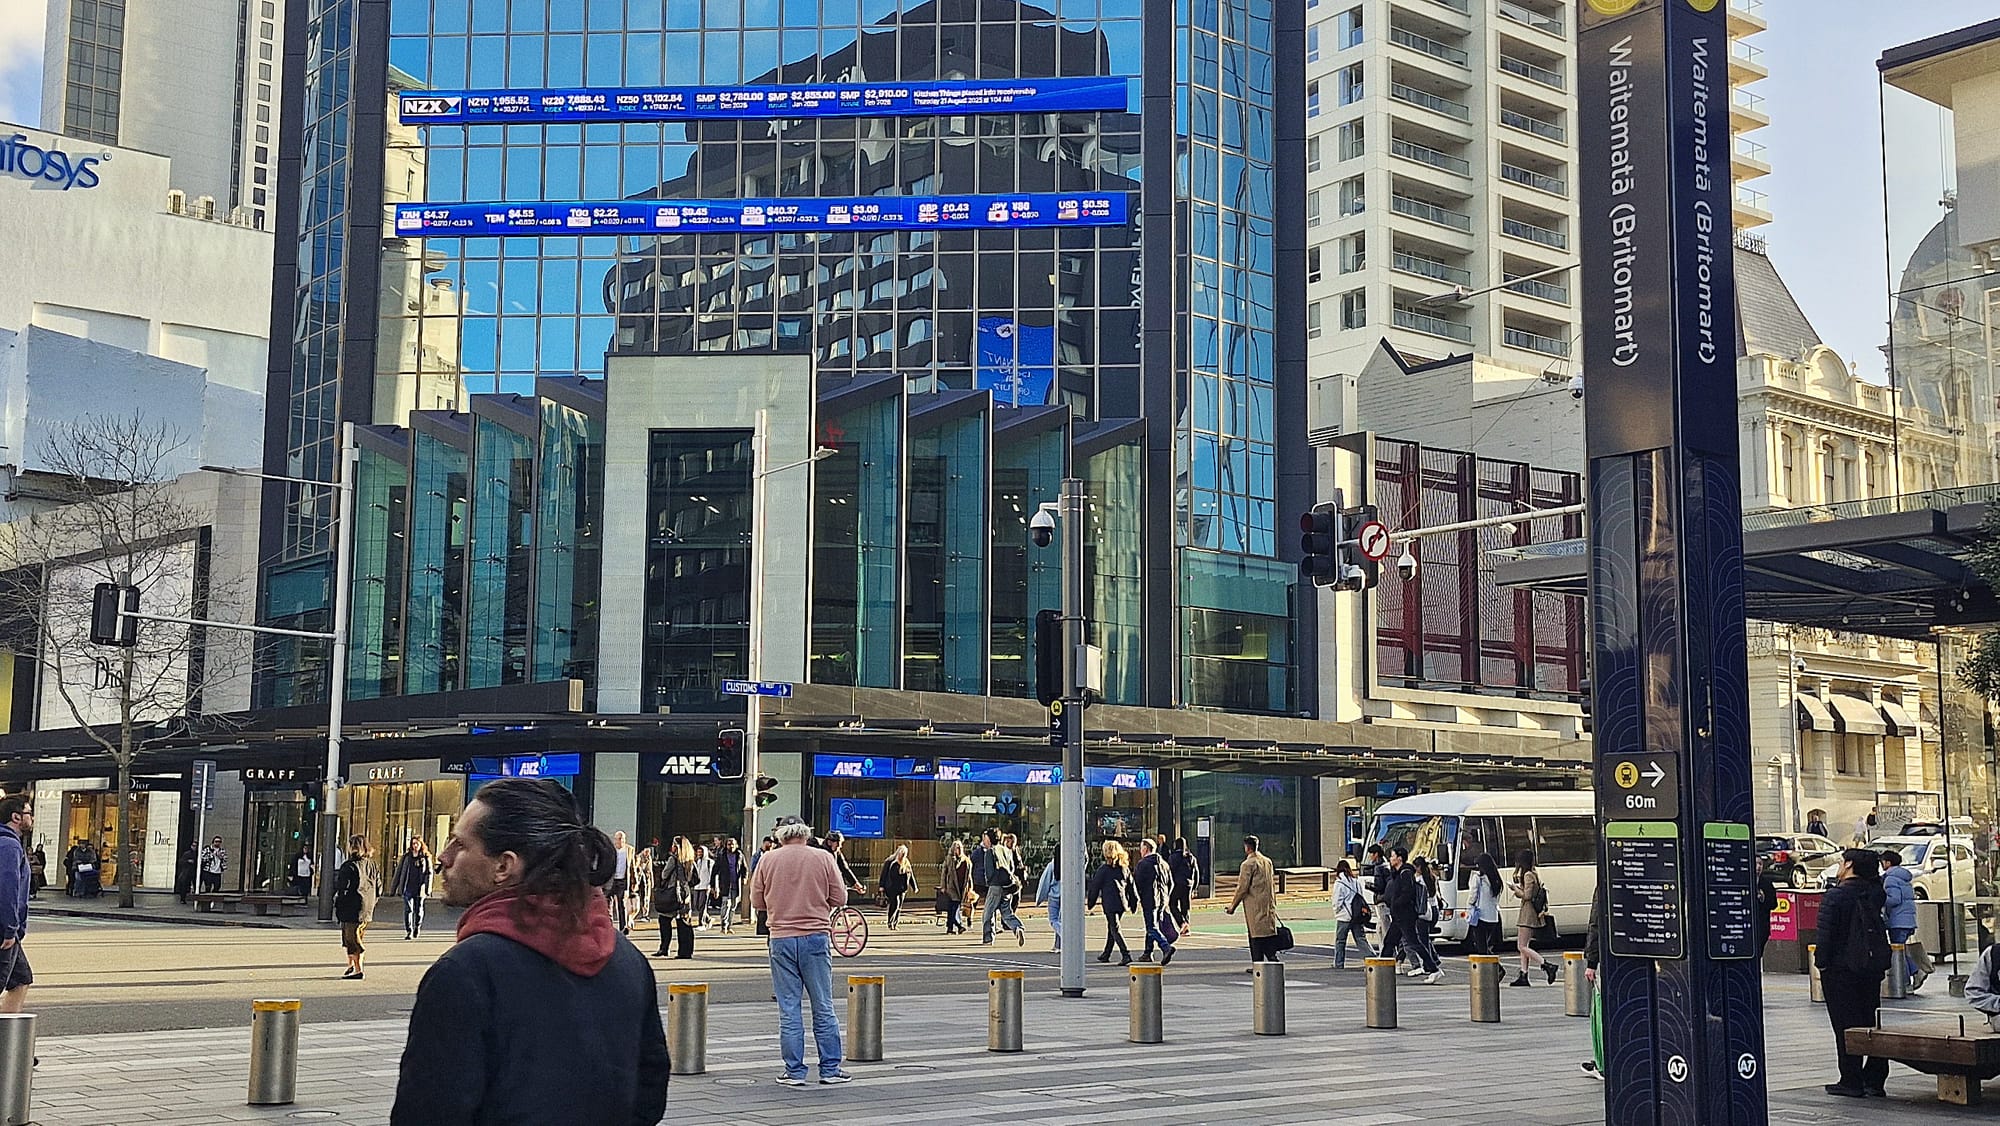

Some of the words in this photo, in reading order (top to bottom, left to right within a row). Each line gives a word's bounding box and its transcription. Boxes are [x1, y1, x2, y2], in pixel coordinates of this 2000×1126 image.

[542, 97, 565, 105] NZ20
[617, 96, 639, 104] NZ50
[696, 94, 716, 102] SMP
[768, 93, 788, 102] SMP
[840, 91, 860, 100] SMP
[404, 100, 442, 113] NZX
[468, 98, 489, 106] NZ10
[1609, 35, 1636, 197] Waitematā
[1692, 38, 1713, 191] Waitematā
[0, 134, 99, 190] fosys
[743, 207, 763, 215] EBO
[767, 206, 799, 215] $40.37
[830, 206, 848, 214] FBU
[919, 204, 938, 212] GBP
[942, 203, 969, 212] £0.43
[989, 202, 1007, 211] JPY
[1059, 201, 1078, 209] USD
[401, 211, 420, 219] TAH
[424, 210, 449, 219] $4.37
[485, 214, 505, 223] TEM
[508, 209, 534, 219] $4.55
[593, 208, 619, 217] $2.22
[658, 208, 678, 216] CNU
[1609, 203, 1638, 367] (Britomart)
[1694, 200, 1716, 365] (Britomart)
[725, 682, 758, 693] CUSTOMS
[519, 761, 539, 775] ANZ
[660, 756, 711, 774] ANZ
[833, 762, 862, 776] ANZ
[246, 769, 295, 780] GRAFF
[369, 767, 404, 780] GRAFF
[934, 765, 961, 780] ANZ
[1026, 770, 1052, 783] ANZ
[1112, 773, 1136, 787] ANZ
[957, 795, 997, 814] ANZ
[1625, 795, 1656, 809] 60m
[1779, 915, 1791, 923] bus
